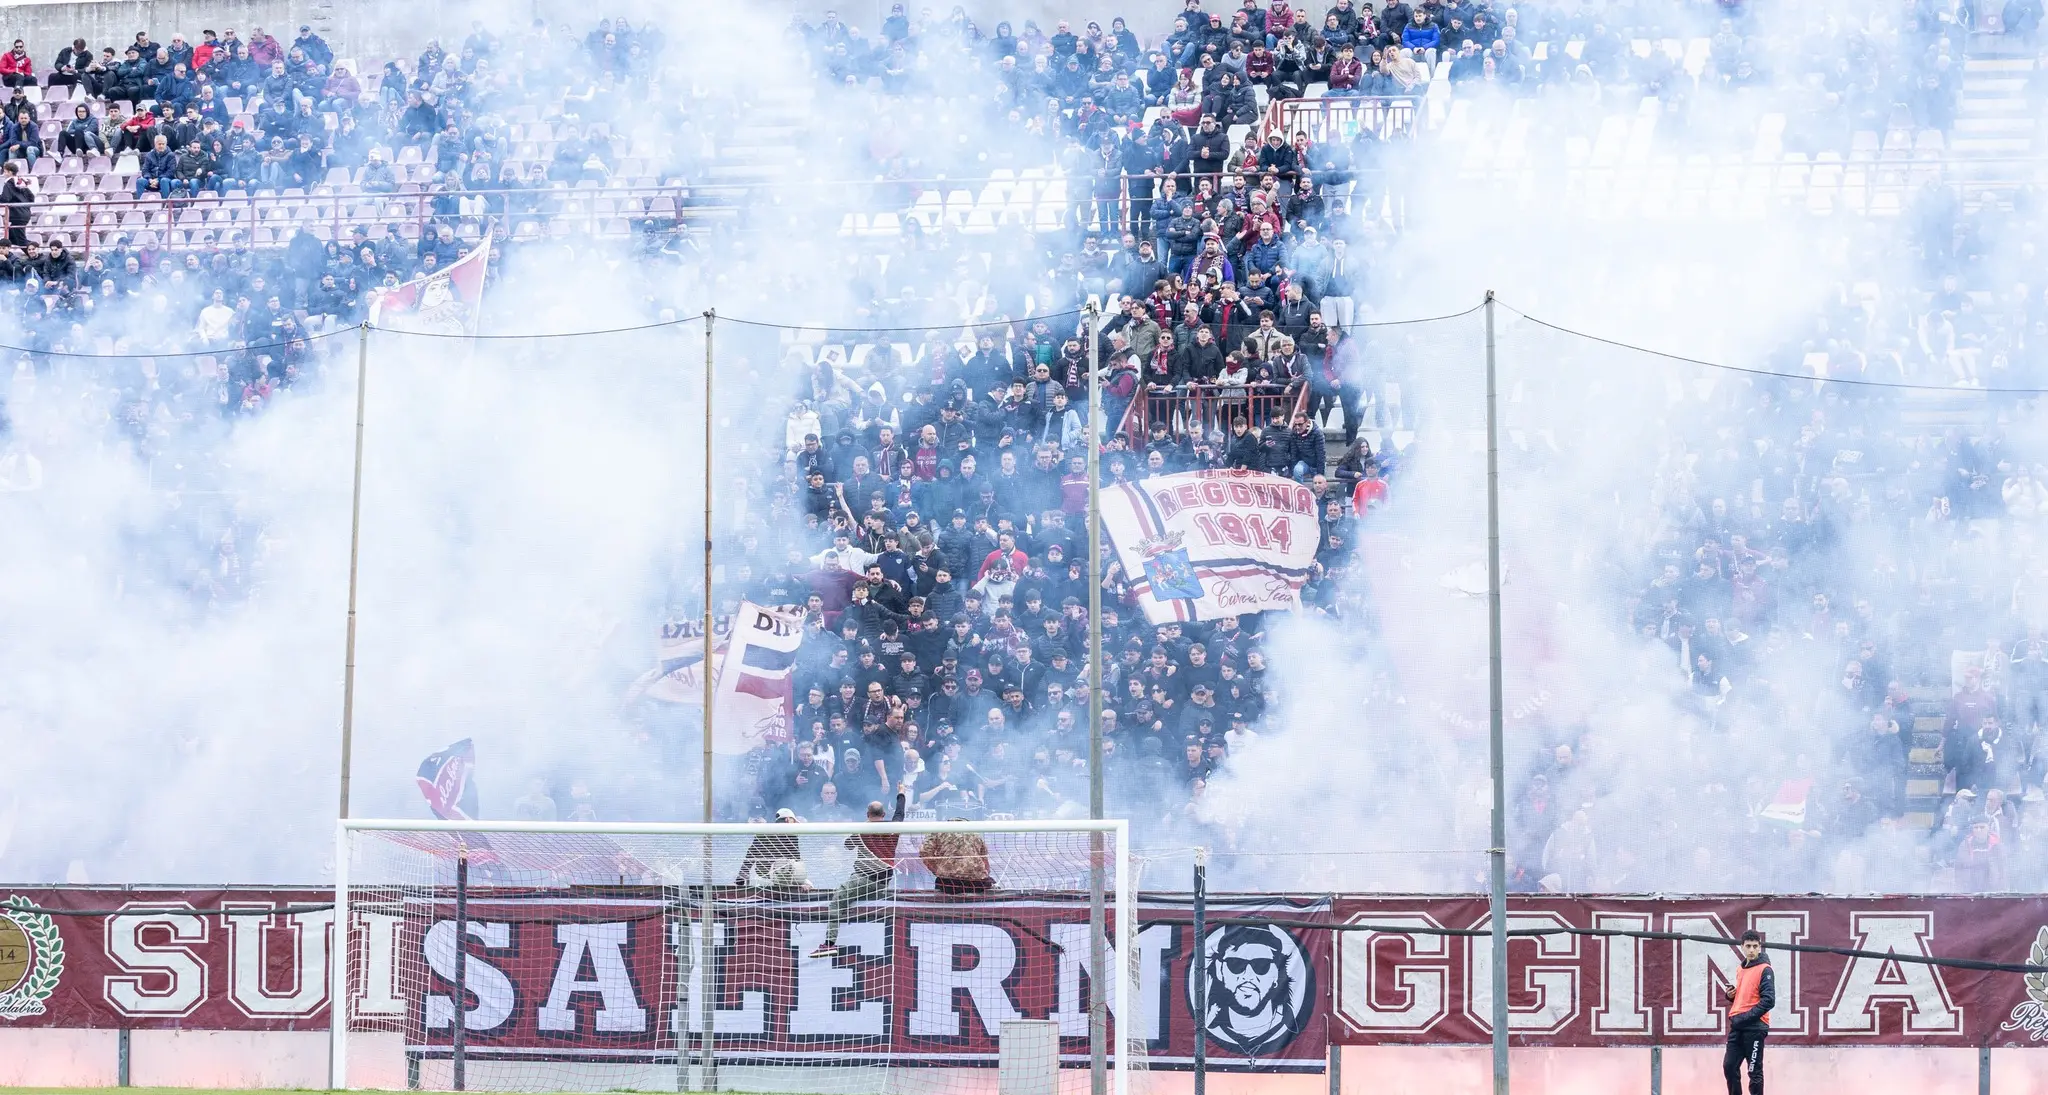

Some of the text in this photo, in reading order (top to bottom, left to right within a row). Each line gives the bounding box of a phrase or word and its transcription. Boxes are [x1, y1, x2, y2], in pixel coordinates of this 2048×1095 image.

[1153, 481, 1314, 521] REGGINA
[1193, 512, 1292, 554] 1914
[0, 996, 45, 1018] alabria
